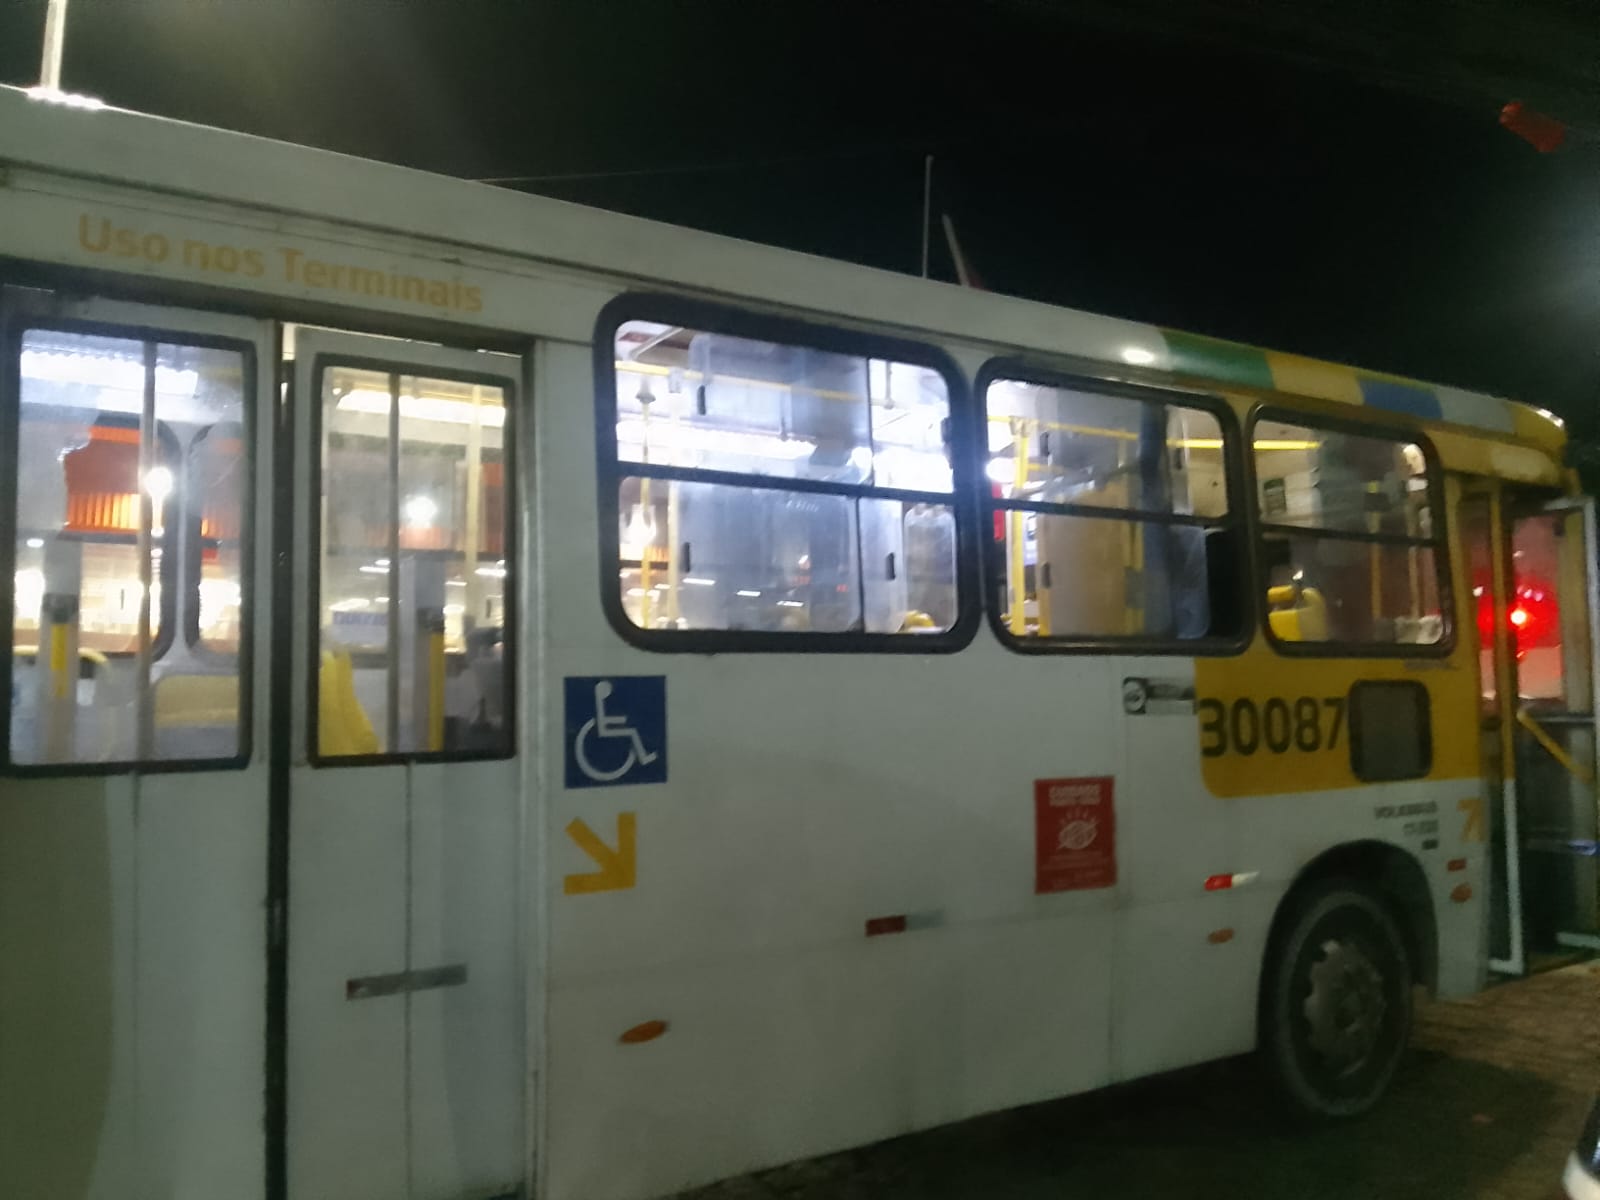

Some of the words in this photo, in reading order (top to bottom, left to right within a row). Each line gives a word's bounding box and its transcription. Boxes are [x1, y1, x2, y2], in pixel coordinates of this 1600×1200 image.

[78, 213, 170, 263] Uso
[182, 237, 265, 279] nos
[278, 246, 483, 313] Terminais
[1199, 695, 1345, 758] 30087
